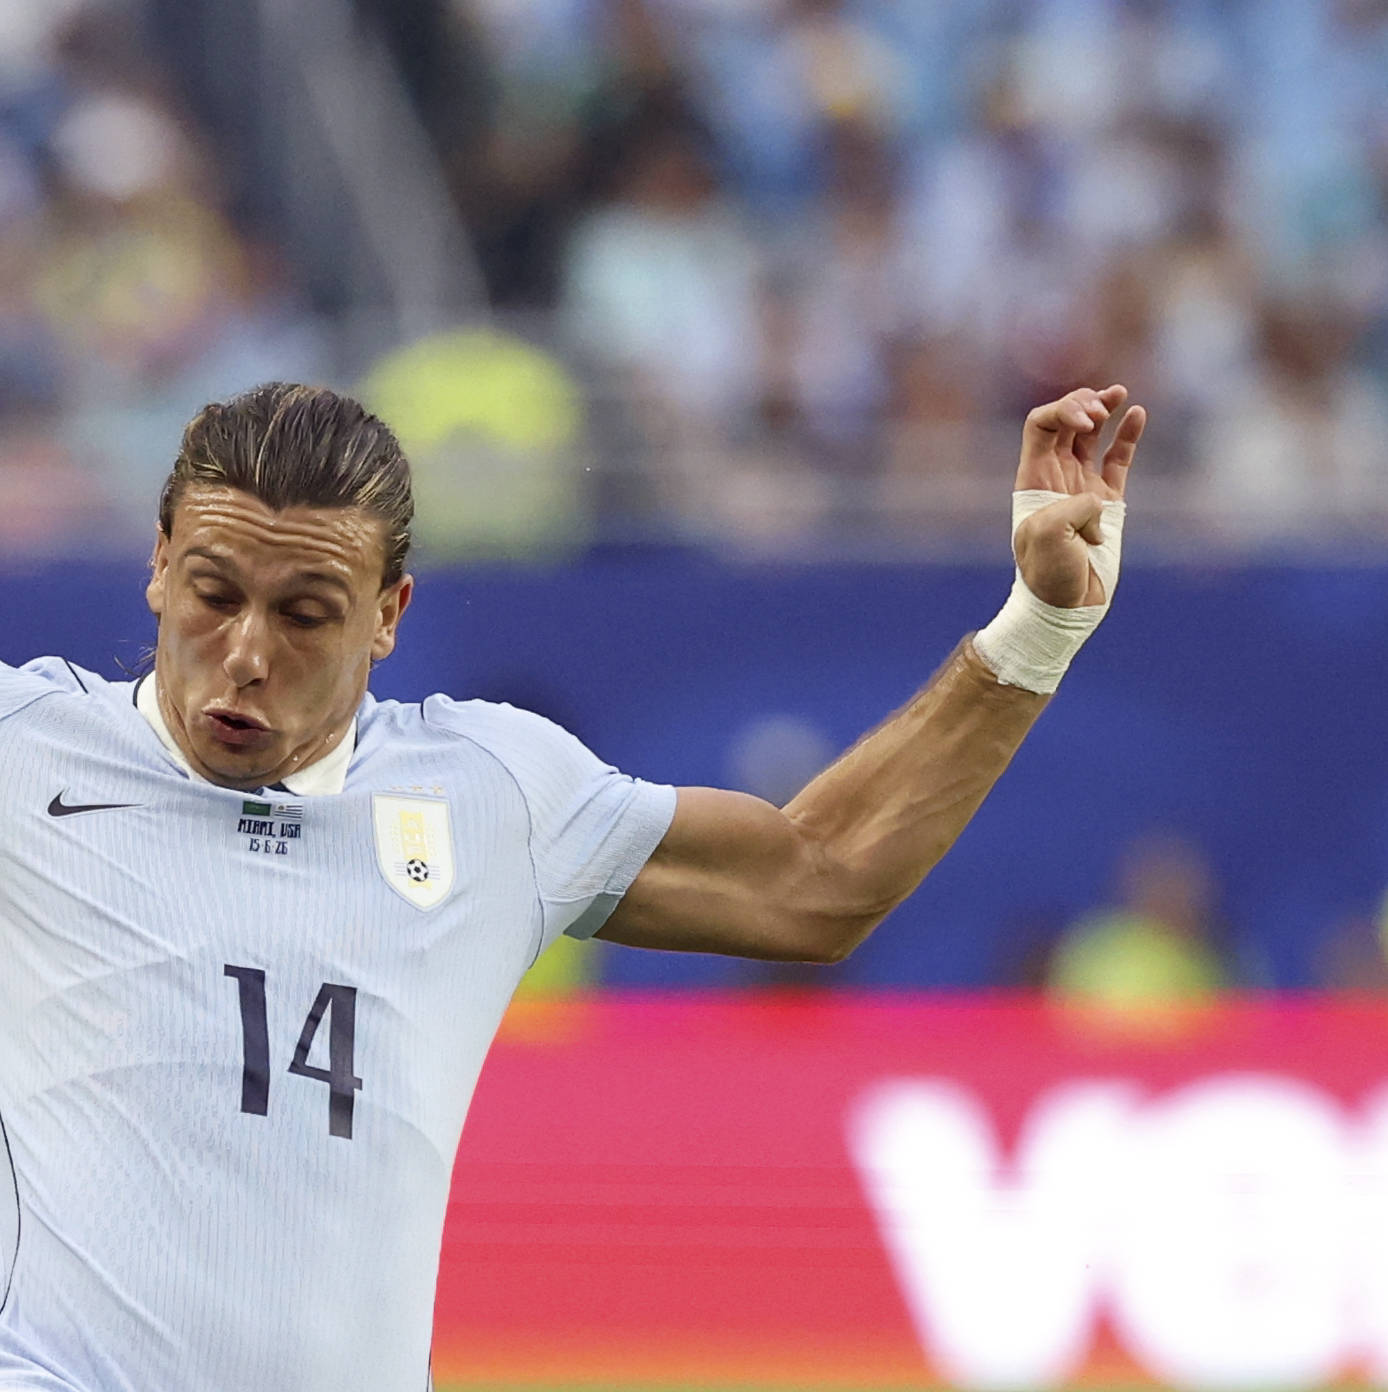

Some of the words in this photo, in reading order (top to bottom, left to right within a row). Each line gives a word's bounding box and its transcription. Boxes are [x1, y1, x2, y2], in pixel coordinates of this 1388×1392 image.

[280, 823, 301, 838] USA
[223, 963, 363, 1140] 14
[846, 1074, 1388, 1392] ve
